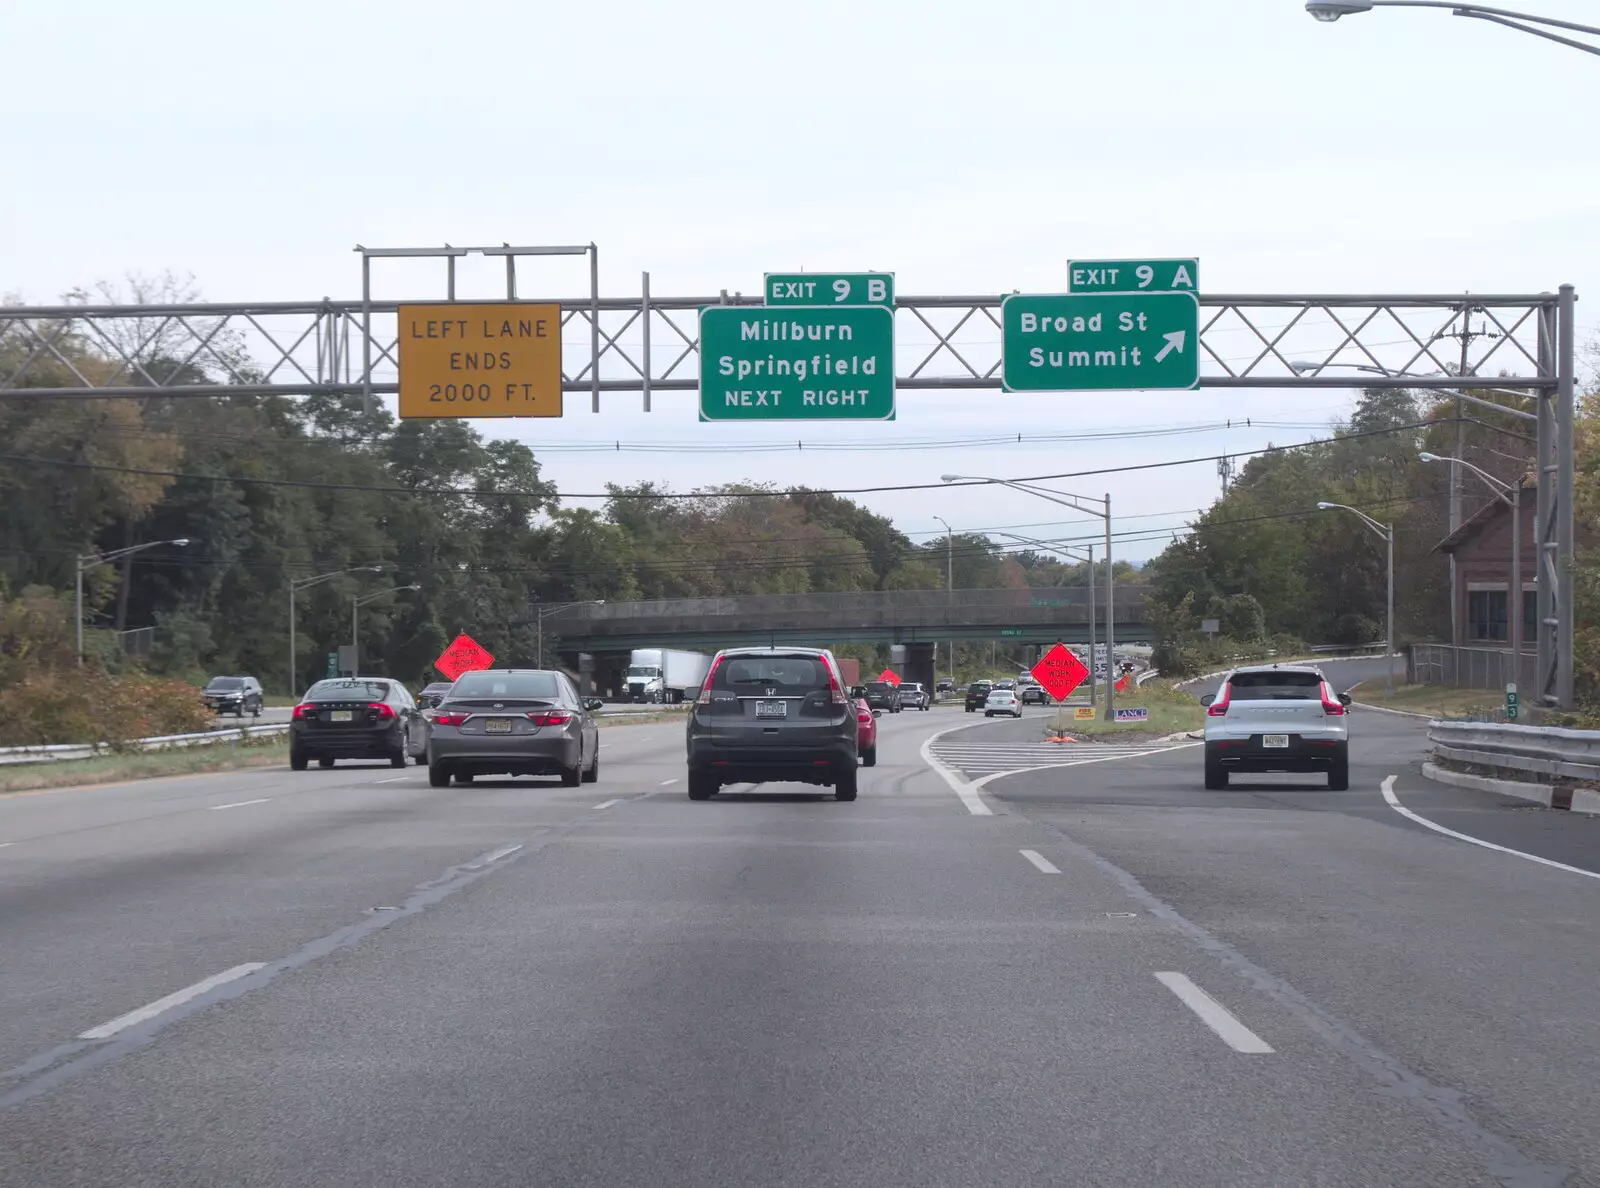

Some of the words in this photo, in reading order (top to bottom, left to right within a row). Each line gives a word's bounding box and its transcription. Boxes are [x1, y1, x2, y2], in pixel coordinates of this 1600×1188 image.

[1073, 269, 1119, 285] EXIT
[1135, 265, 1154, 288] 9
[1171, 265, 1193, 288] A
[773, 282, 816, 298] EXIT
[832, 279, 851, 301] 9
[868, 279, 886, 301] B
[412, 321, 467, 338] LEFT
[484, 320, 547, 337] LANE
[741, 320, 852, 340] Millburn
[1021, 313, 1102, 332] Broad
[1119, 312, 1147, 331] St
[451, 352, 511, 370] ENDS
[1029, 346, 1141, 367] Summit
[719, 354, 876, 381] Springfield
[429, 384, 490, 401] 2000
[506, 384, 535, 401] FT.
[725, 391, 782, 406] NEXT
[803, 390, 869, 405] RIGHT
[1045, 659, 1075, 667] MEDIAN
[1049, 669, 1071, 677] WORK
[1048, 679, 1063, 687] 1000
[1508, 694, 1515, 704] 9
